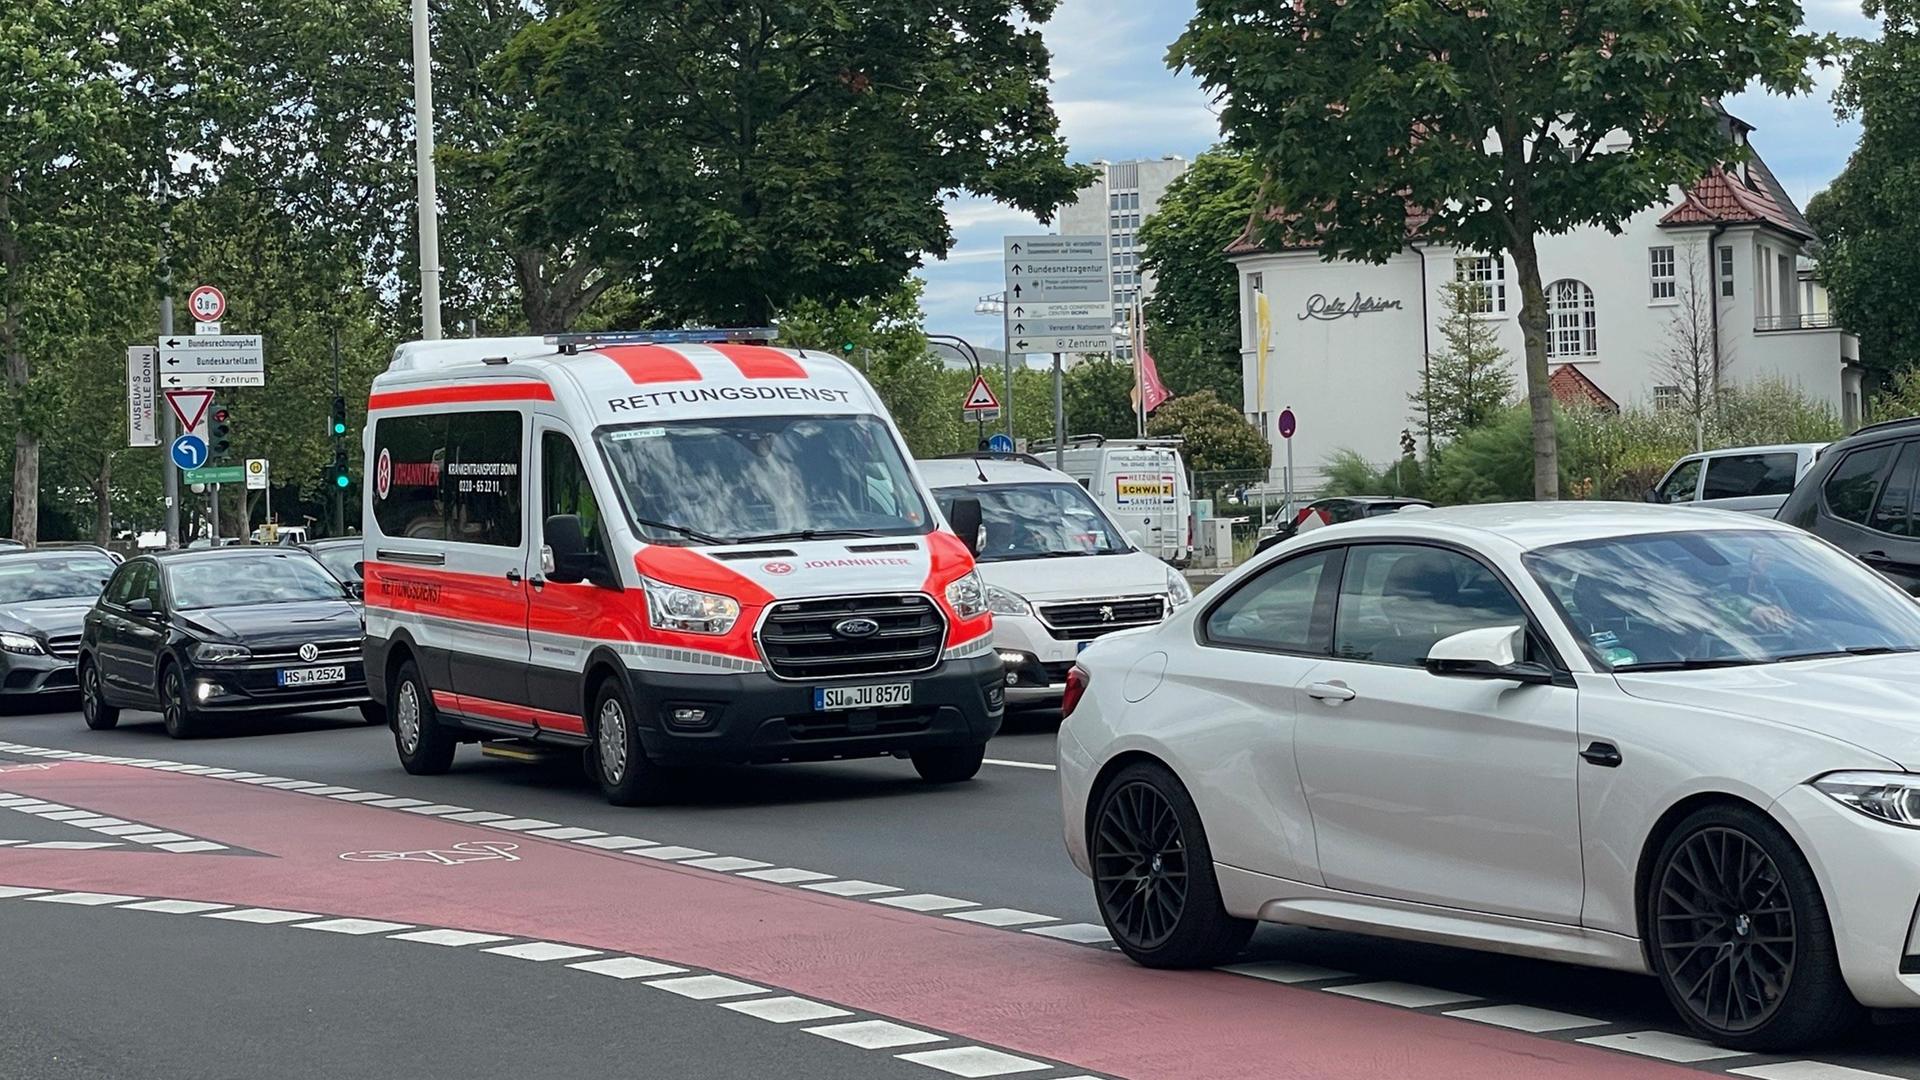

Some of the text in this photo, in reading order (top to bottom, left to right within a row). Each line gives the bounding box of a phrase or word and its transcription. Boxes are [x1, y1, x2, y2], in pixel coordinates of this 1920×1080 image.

[1027, 264, 1103, 275] Bundesnetzagentur
[188, 338, 257, 349] Bundesrechnungshof
[1067, 339, 1108, 349] Zentrum
[196, 356, 258, 367] Bundeskartellamt
[142, 353, 152, 383] BONN
[219, 376, 260, 384] Zentrum
[608, 387, 849, 413] RETTUNGSDIENST
[393, 463, 441, 486] JOHANNITER
[448, 463, 518, 475] KRANKENTRANSPORT BONN
[476, 480, 485, 492] 65
[484, 480, 492, 492] 22
[804, 557, 911, 570] JOHANNITER
[381, 580, 441, 604] RETTUNGSDIENST
[285, 671, 300, 683] HS
[316, 668, 344, 681] 2524
[825, 684, 910, 707] SU JU 8570
